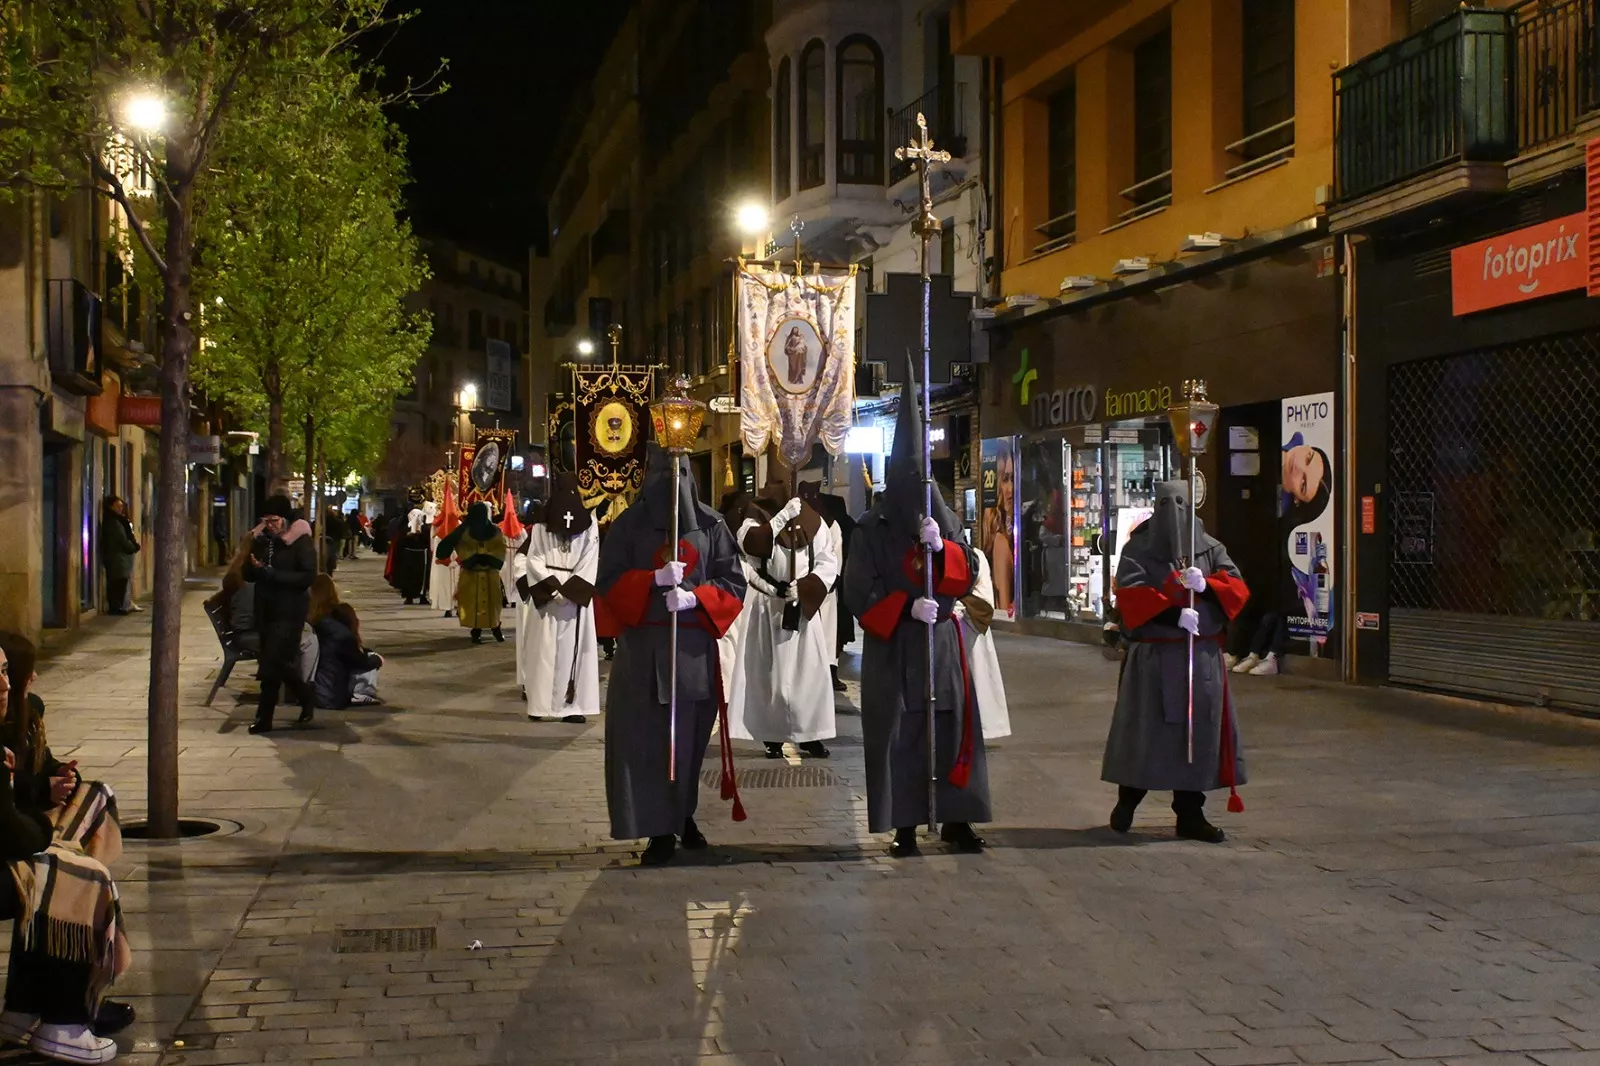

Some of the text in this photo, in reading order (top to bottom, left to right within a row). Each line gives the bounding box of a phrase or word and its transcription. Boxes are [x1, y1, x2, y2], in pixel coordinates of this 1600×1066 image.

[1484, 225, 1579, 280] fotoprix
[1032, 381, 1172, 427] marro farmacia
[1287, 402, 1328, 422] PHYTO
